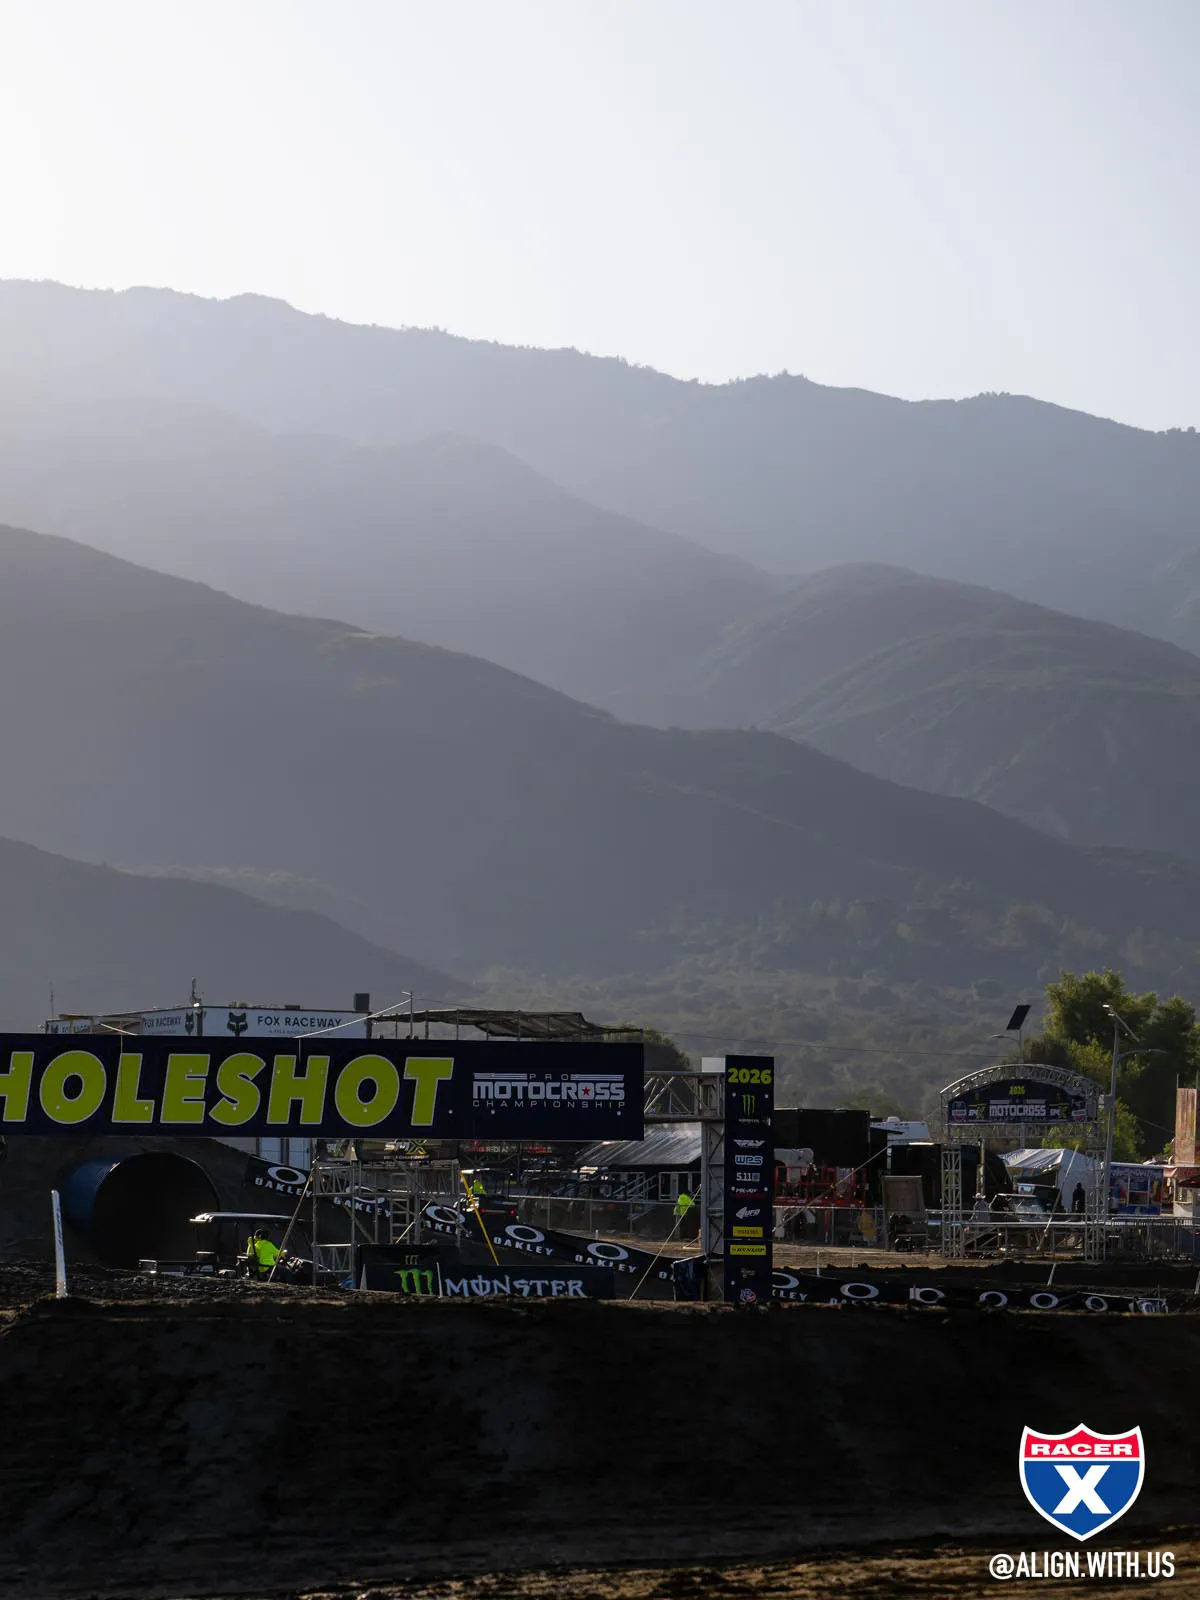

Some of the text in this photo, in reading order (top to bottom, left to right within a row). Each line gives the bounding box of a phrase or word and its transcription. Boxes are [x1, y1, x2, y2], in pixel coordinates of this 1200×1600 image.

[156, 1016, 181, 1028] RACEWAY
[257, 1015, 342, 1028] FOX RACEWAY
[529, 1073, 570, 1081] PRO
[727, 1067, 773, 1085] 2026
[472, 1081, 626, 1100] MOTOCROSS
[472, 1100, 626, 1108] CHAMPIONSHIP
[989, 1104, 1046, 1117] MOTOCROSS
[254, 1176, 313, 1199] OAKLEY
[493, 1236, 555, 1256] OAKLEY
[574, 1254, 638, 1274] OAKLEY
[444, 1274, 591, 1298] MONSTER
